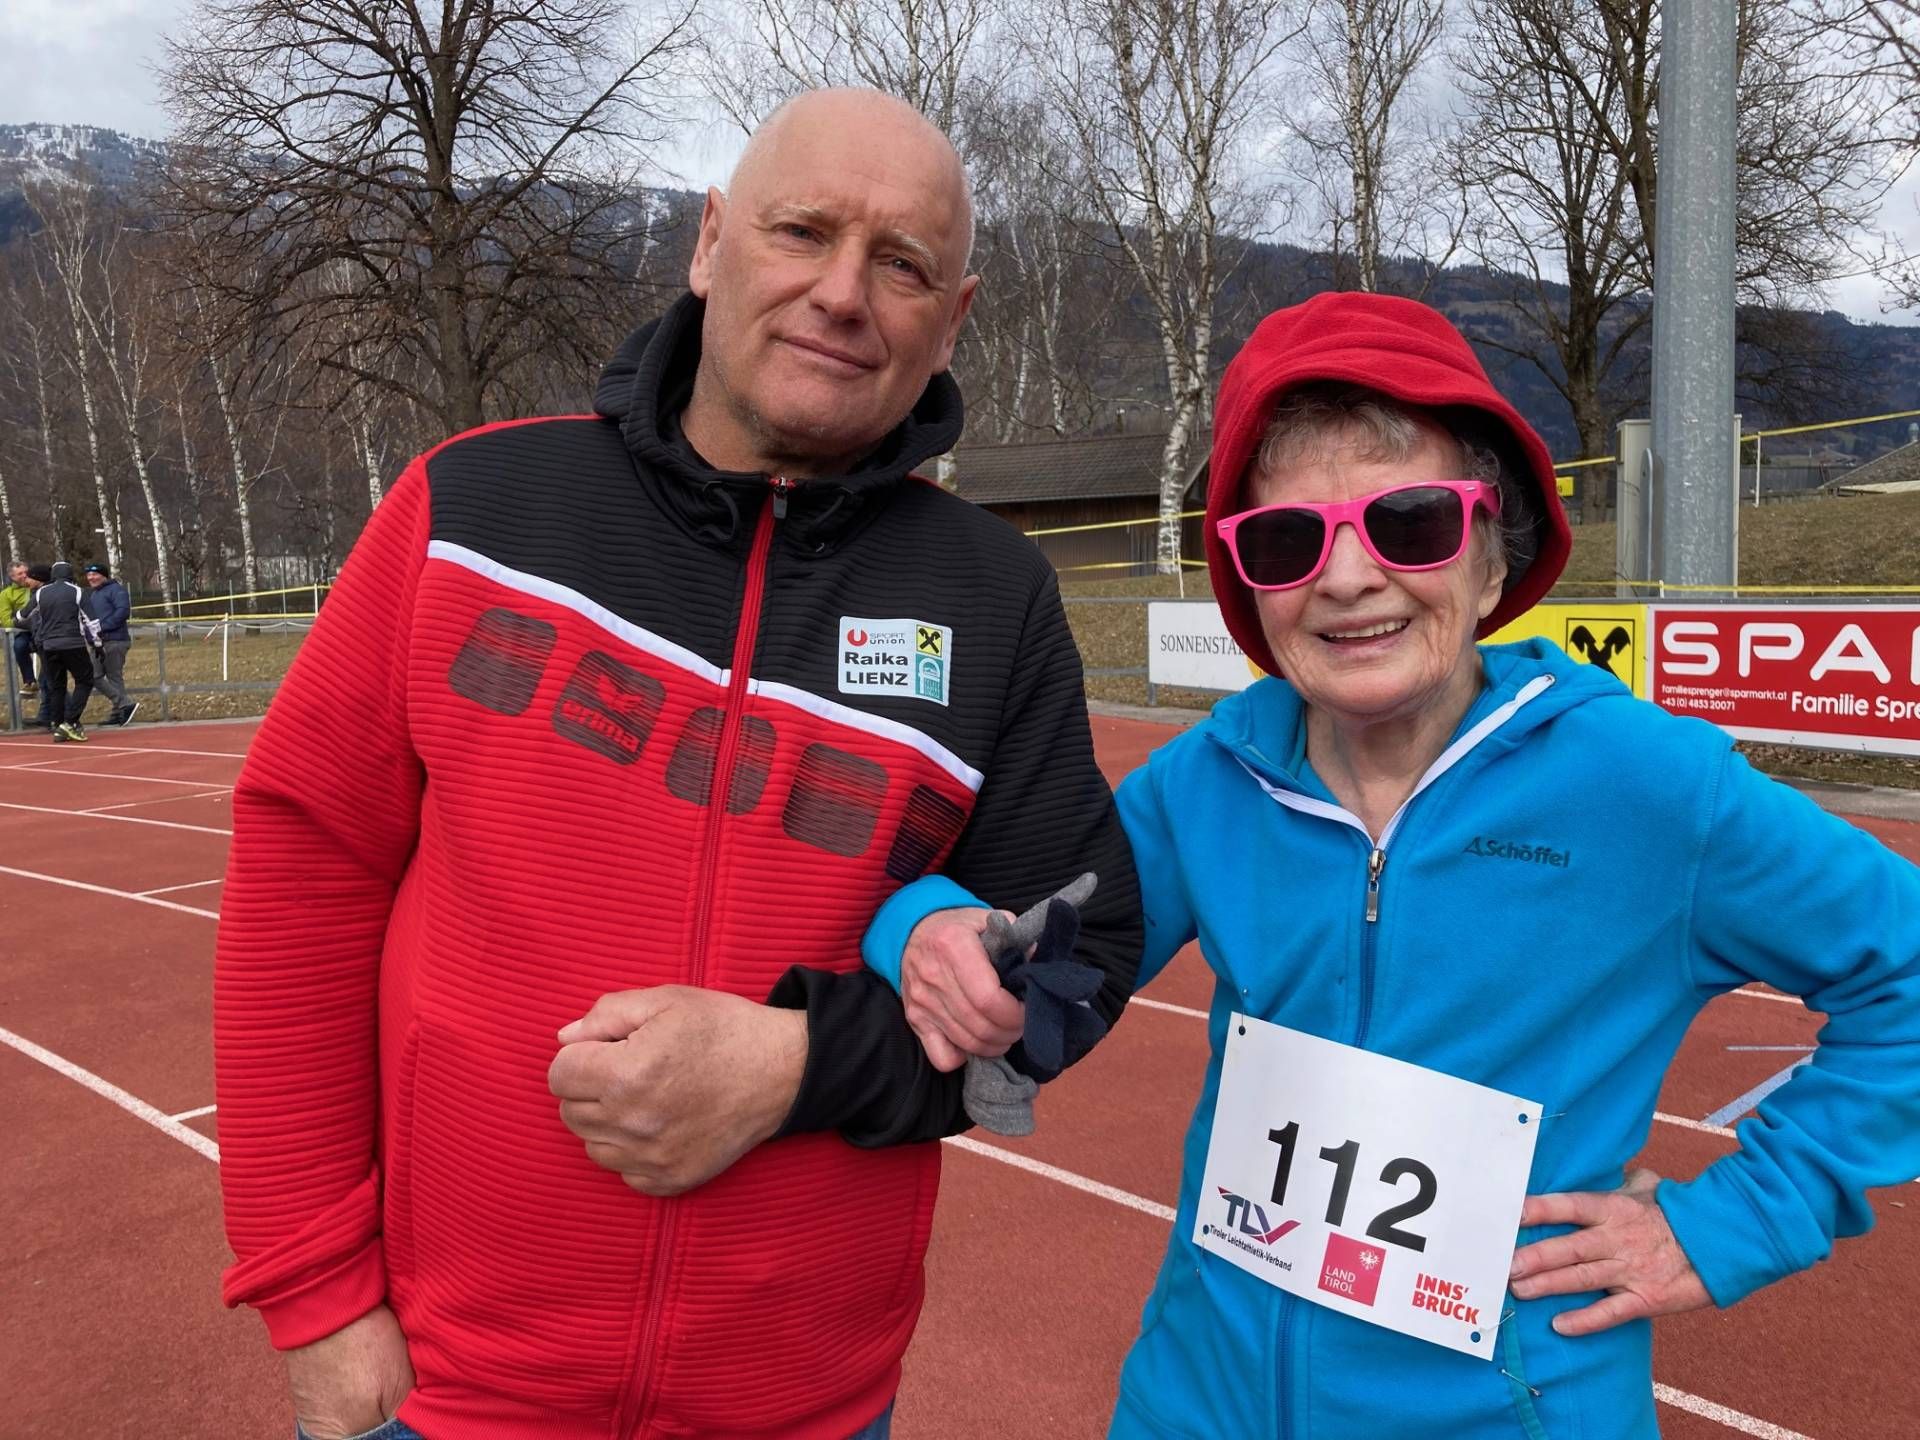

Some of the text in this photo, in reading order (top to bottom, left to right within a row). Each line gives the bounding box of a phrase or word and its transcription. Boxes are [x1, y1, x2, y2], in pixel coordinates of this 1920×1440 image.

[844, 652, 908, 666] Raika
[1662, 621, 1920, 686] SPA
[846, 671, 908, 686] LIENZ
[1662, 698, 1676, 707] +43
[1709, 701, 1735, 711] 20071
[1791, 691, 1869, 716] Familie
[1267, 1120, 1438, 1253] 112
[1218, 1186, 1302, 1246] TLV
[1209, 1224, 1293, 1272] Tiroler Leichtathletik-Verband
[1323, 1274, 1355, 1295] TIROL
[1325, 1264, 1357, 1283] LAND
[1411, 1290, 1480, 1325] BRUCK
